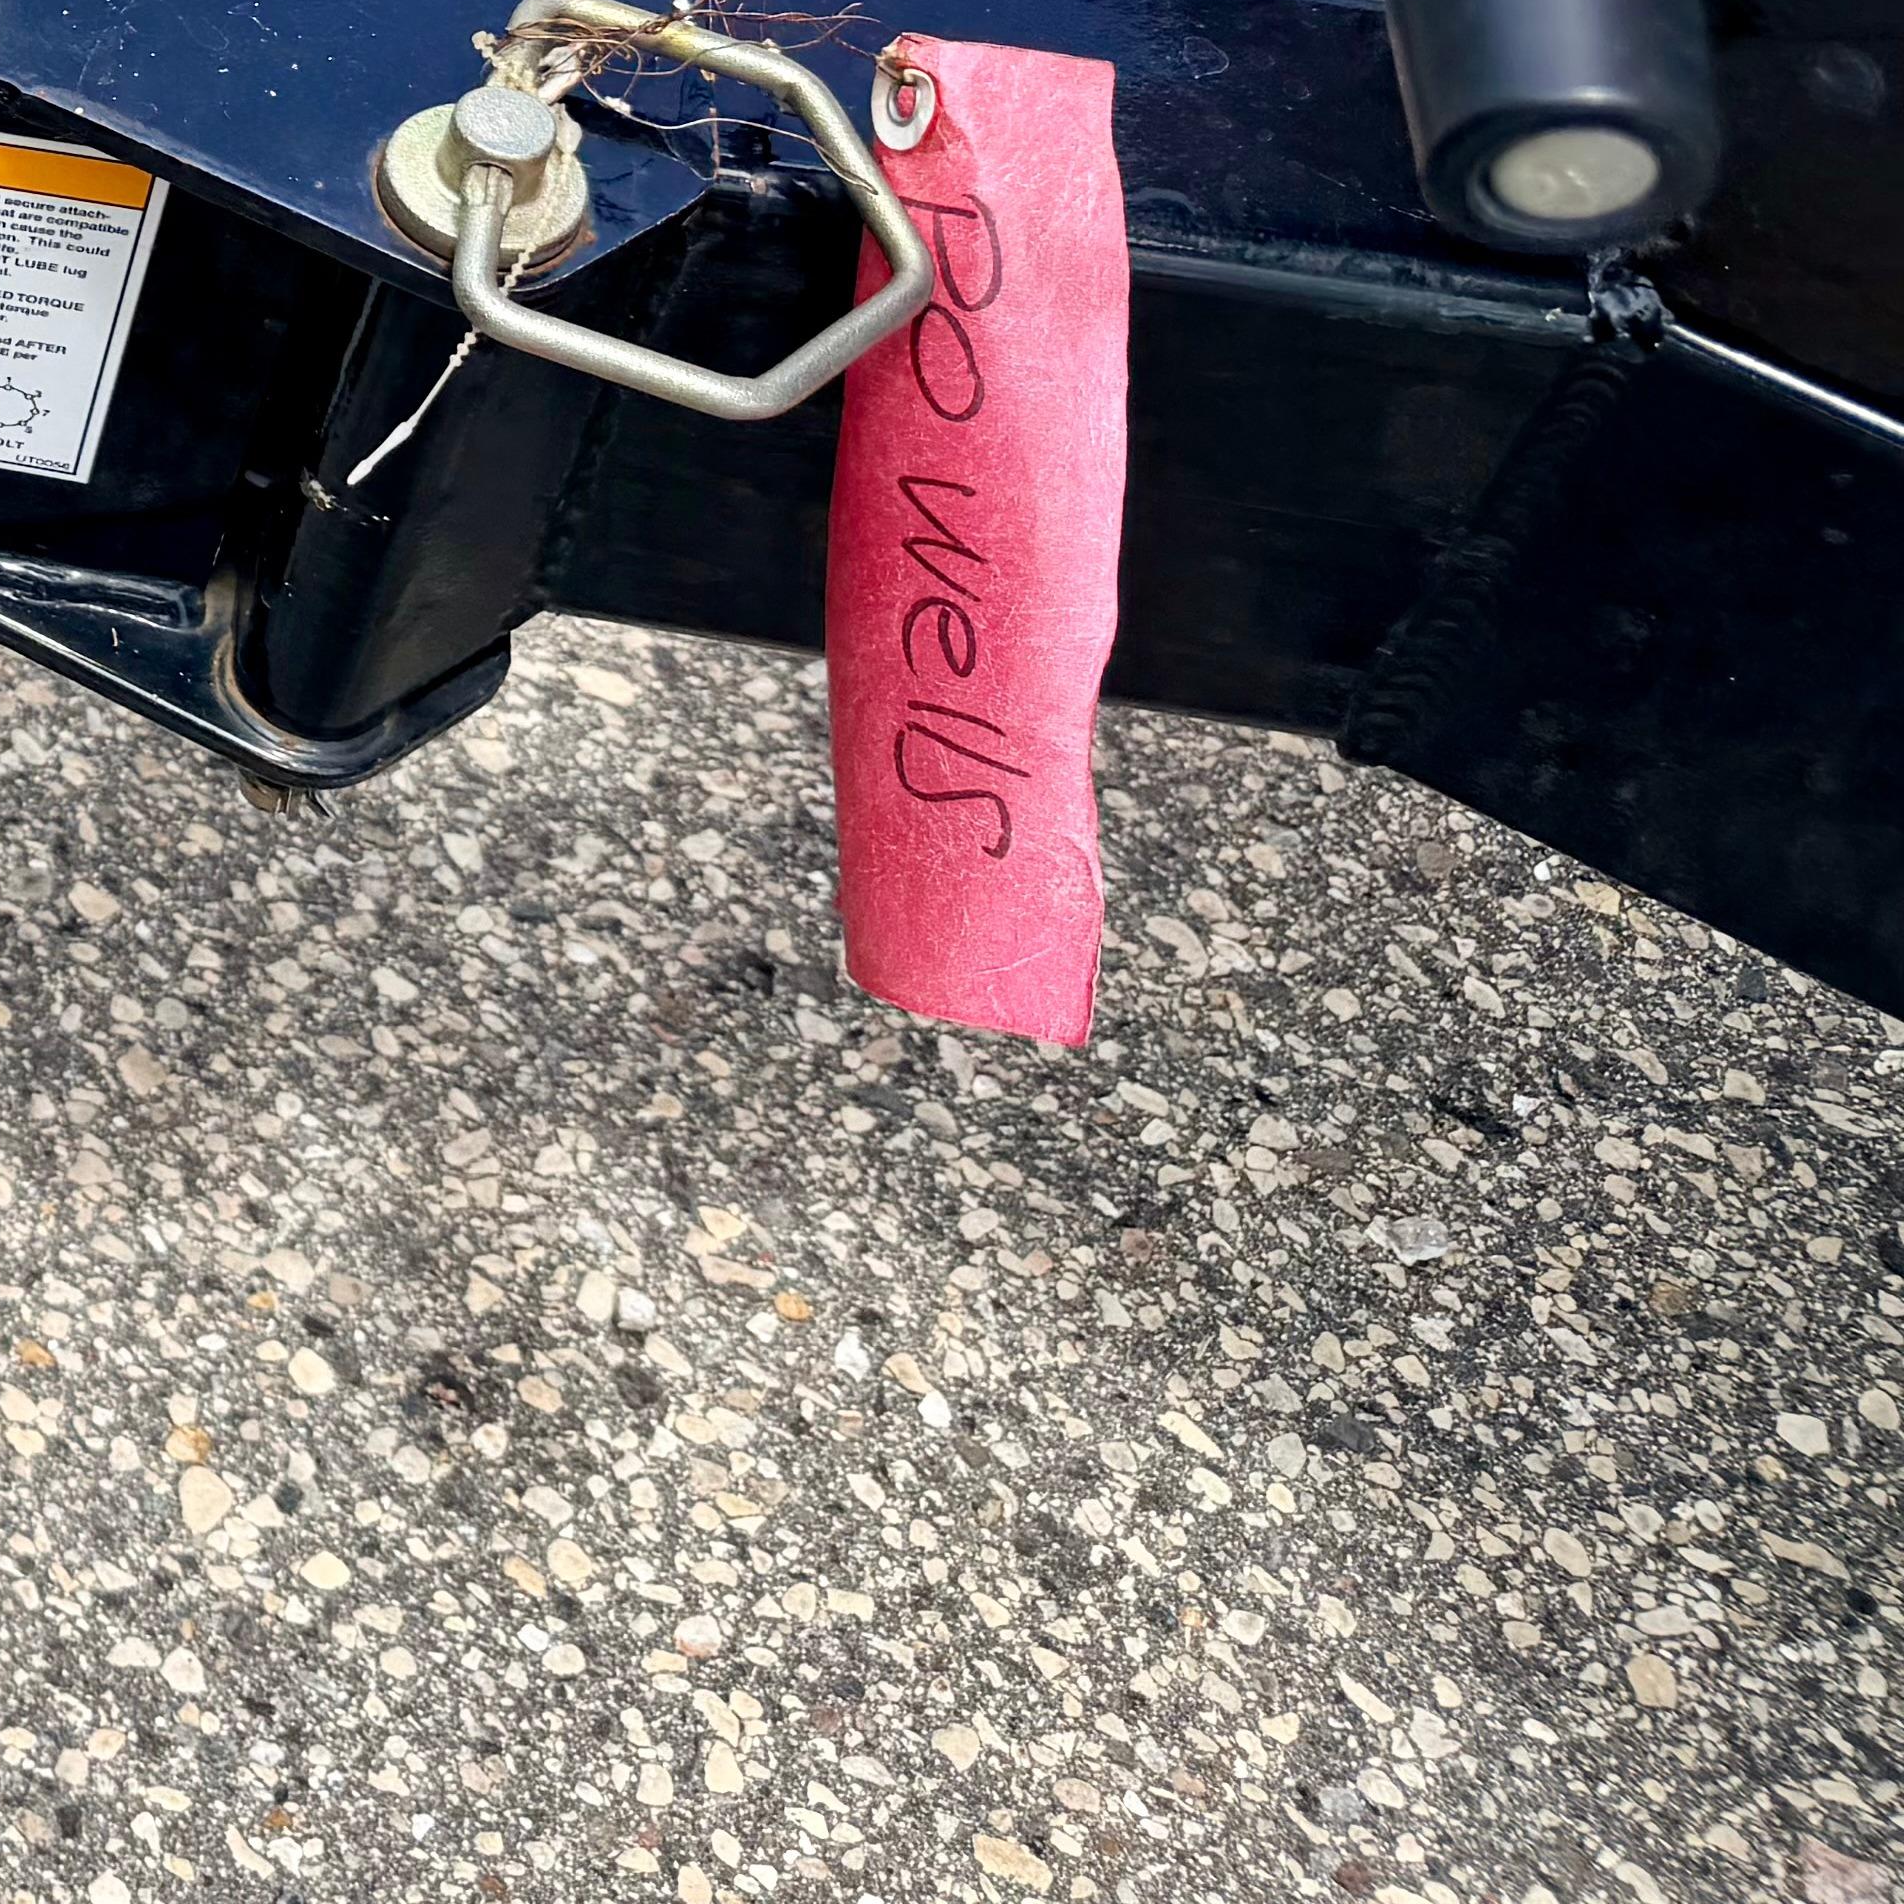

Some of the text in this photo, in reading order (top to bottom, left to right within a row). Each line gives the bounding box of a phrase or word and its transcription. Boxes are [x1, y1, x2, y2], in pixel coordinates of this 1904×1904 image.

[3, 197, 57, 213] secure
[9, 222, 57, 237] cause
[58, 228, 84, 241] the
[17, 211, 44, 223] are
[45, 216, 130, 237] compatible
[27, 235, 62, 250] This
[65, 242, 111, 258] could
[13, 257, 60, 273] LUBE
[62, 265, 88, 279] lug
